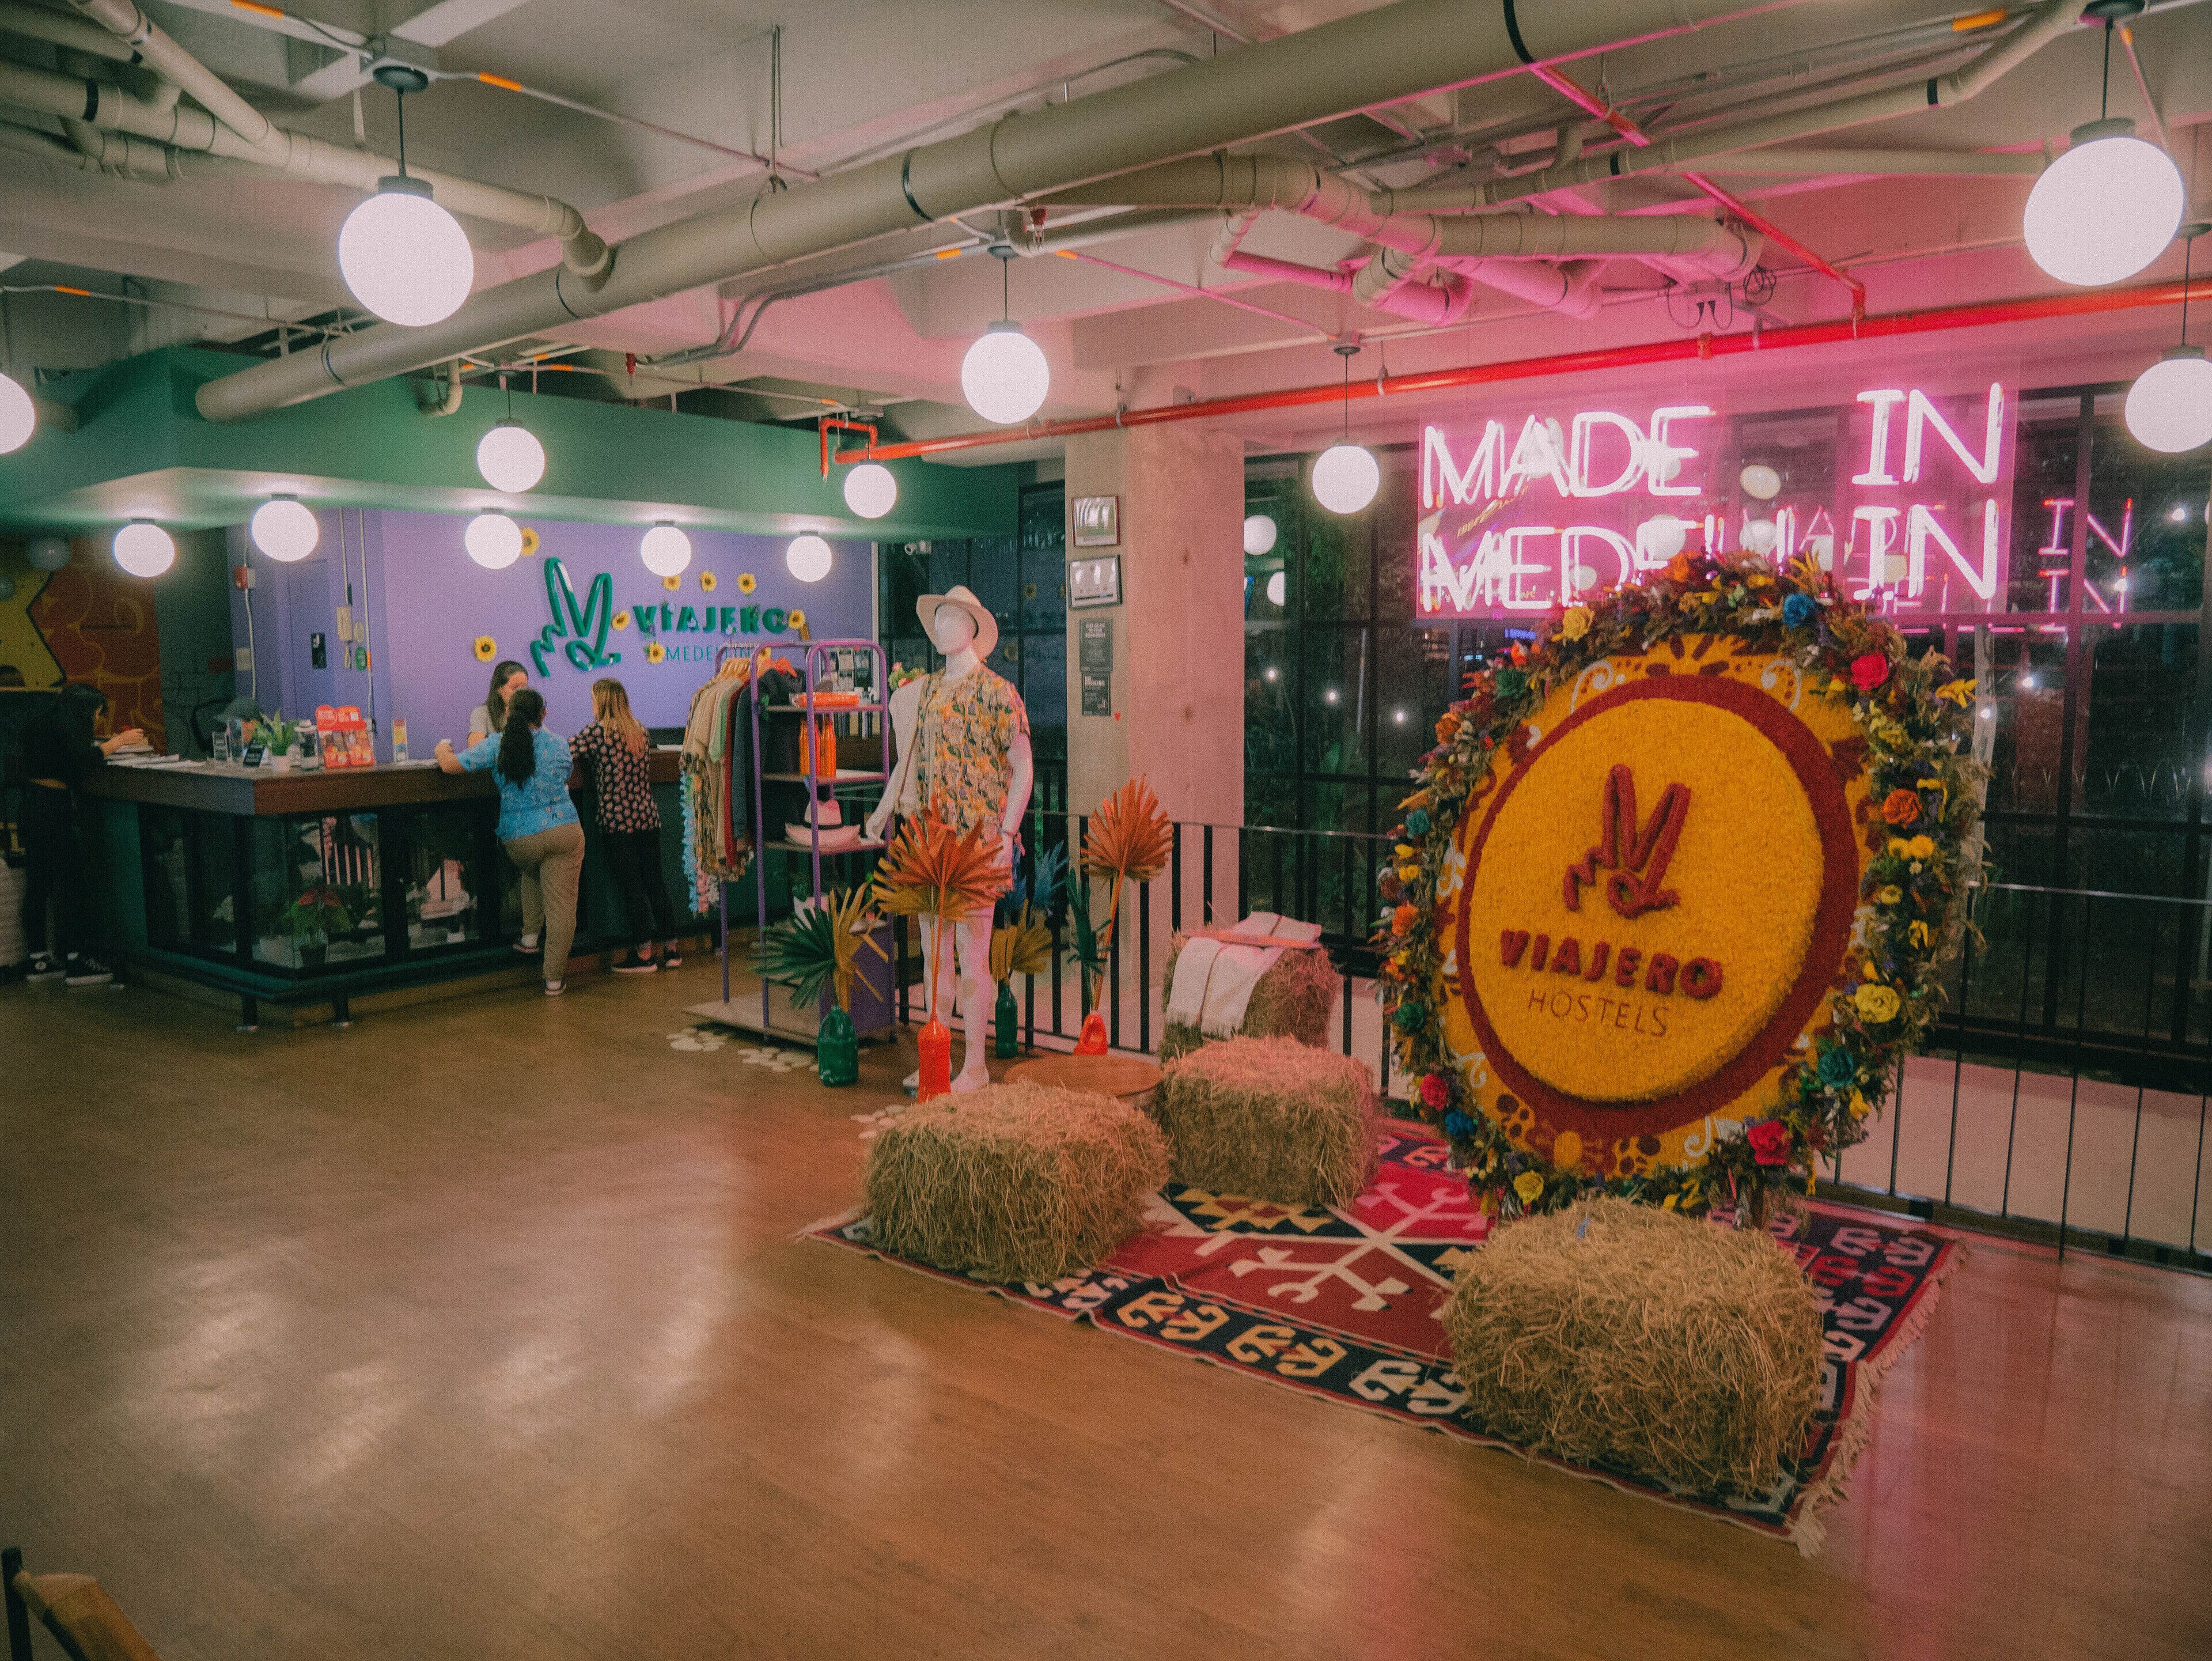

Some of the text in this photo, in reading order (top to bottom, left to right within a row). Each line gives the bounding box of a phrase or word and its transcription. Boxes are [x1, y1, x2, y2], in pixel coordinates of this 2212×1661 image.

[1422, 382, 2003, 508] MADE IN
[632, 603, 789, 635] VIAJERO
[665, 644, 751, 662] MEDEIN
[1500, 929, 1722, 1000] VIAJERO
[1528, 989, 1669, 1038] HOSTELS
